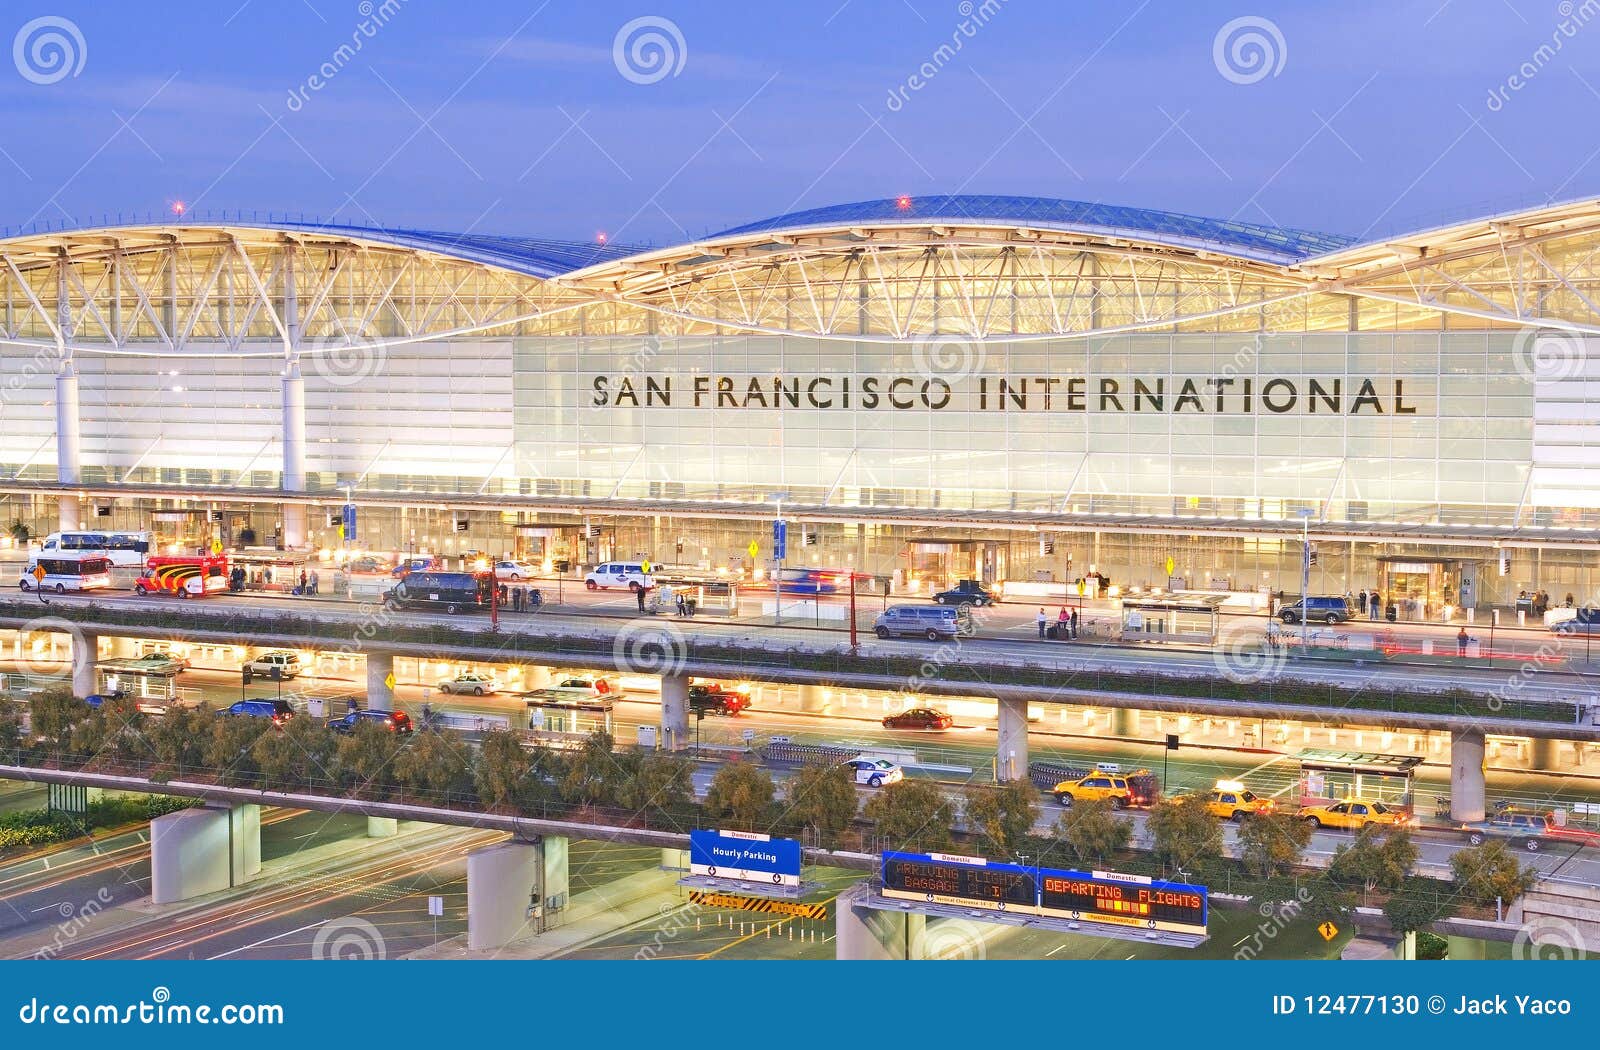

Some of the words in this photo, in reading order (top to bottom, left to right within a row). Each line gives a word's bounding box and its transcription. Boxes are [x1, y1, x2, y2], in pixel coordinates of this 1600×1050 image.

[593, 375, 671, 407] SAN
[693, 376, 951, 411] FRANCISCO
[980, 376, 1417, 415] INTERNATIONAL
[713, 847, 741, 859] Hourly
[743, 851, 777, 863] Parking
[941, 854, 971, 863] Domestic
[896, 862, 959, 881] ARRIVING
[967, 870, 1024, 887] FLIGHTS
[1106, 872, 1138, 882] Domestic
[1045, 878, 1122, 899] DEPARTING
[1138, 889, 1201, 908] FLIGHTS
